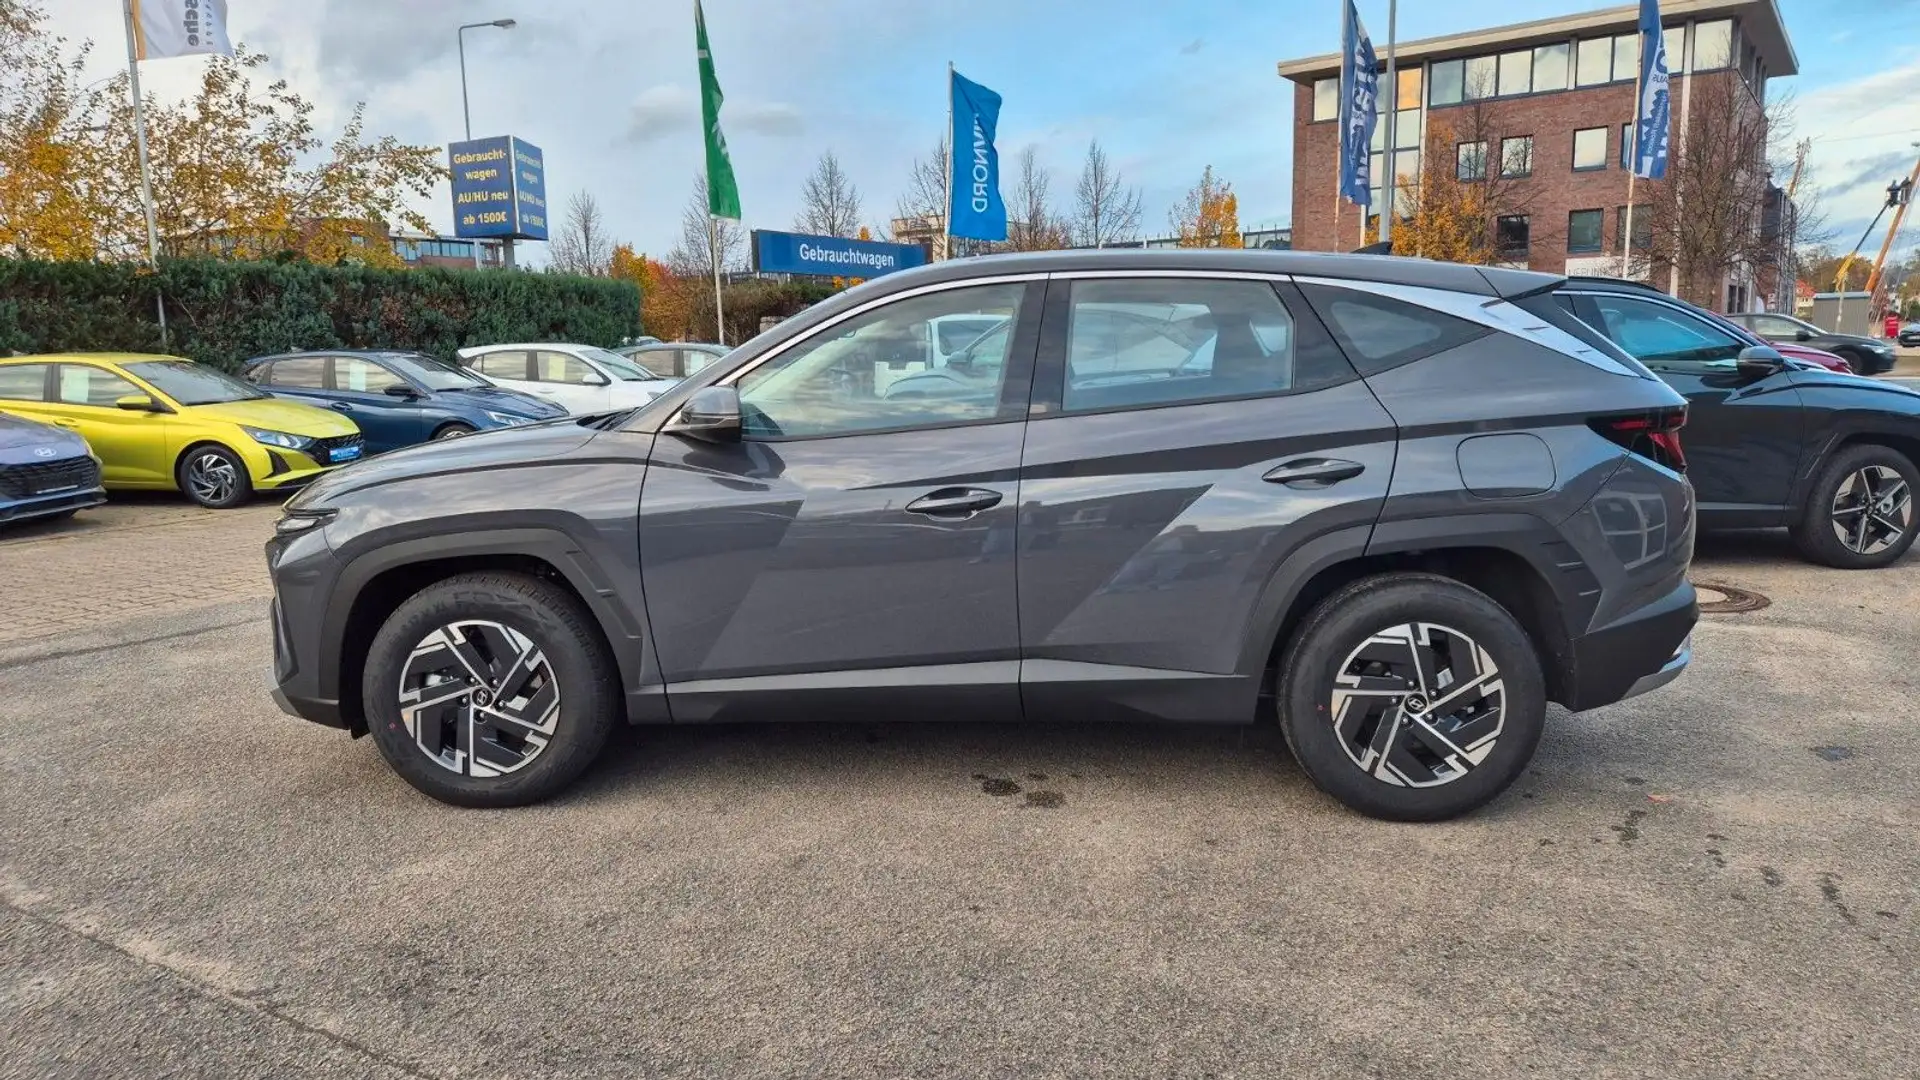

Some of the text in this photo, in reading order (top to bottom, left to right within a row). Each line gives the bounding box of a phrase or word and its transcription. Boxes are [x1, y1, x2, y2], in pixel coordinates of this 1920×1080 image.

[453, 149, 506, 163] Gebraucht-
[465, 169, 497, 181] wagen
[458, 191, 508, 203] AU/HU neu
[463, 212, 507, 225] ab 1500€
[799, 243, 895, 269] Gebrauchtwagen
